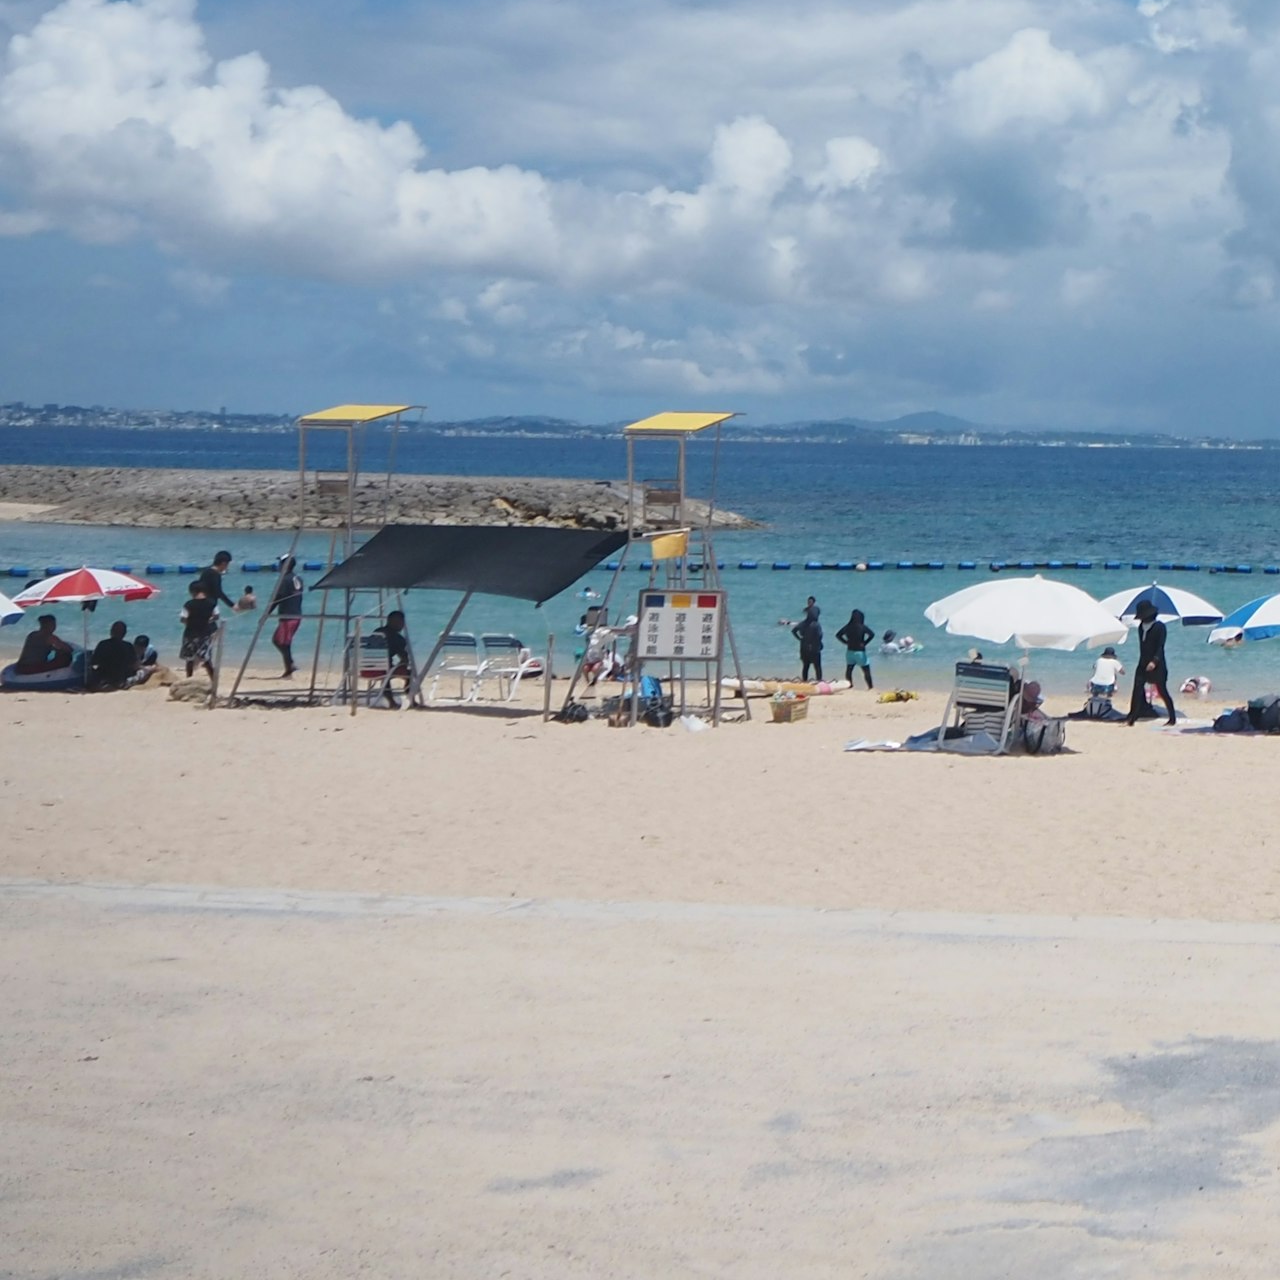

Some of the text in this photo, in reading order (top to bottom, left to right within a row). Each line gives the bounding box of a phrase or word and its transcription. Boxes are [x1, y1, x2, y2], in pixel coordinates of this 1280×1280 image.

[673, 613, 686, 655] 遊泳注意
[700, 613, 713, 656] 遊泳禁止
